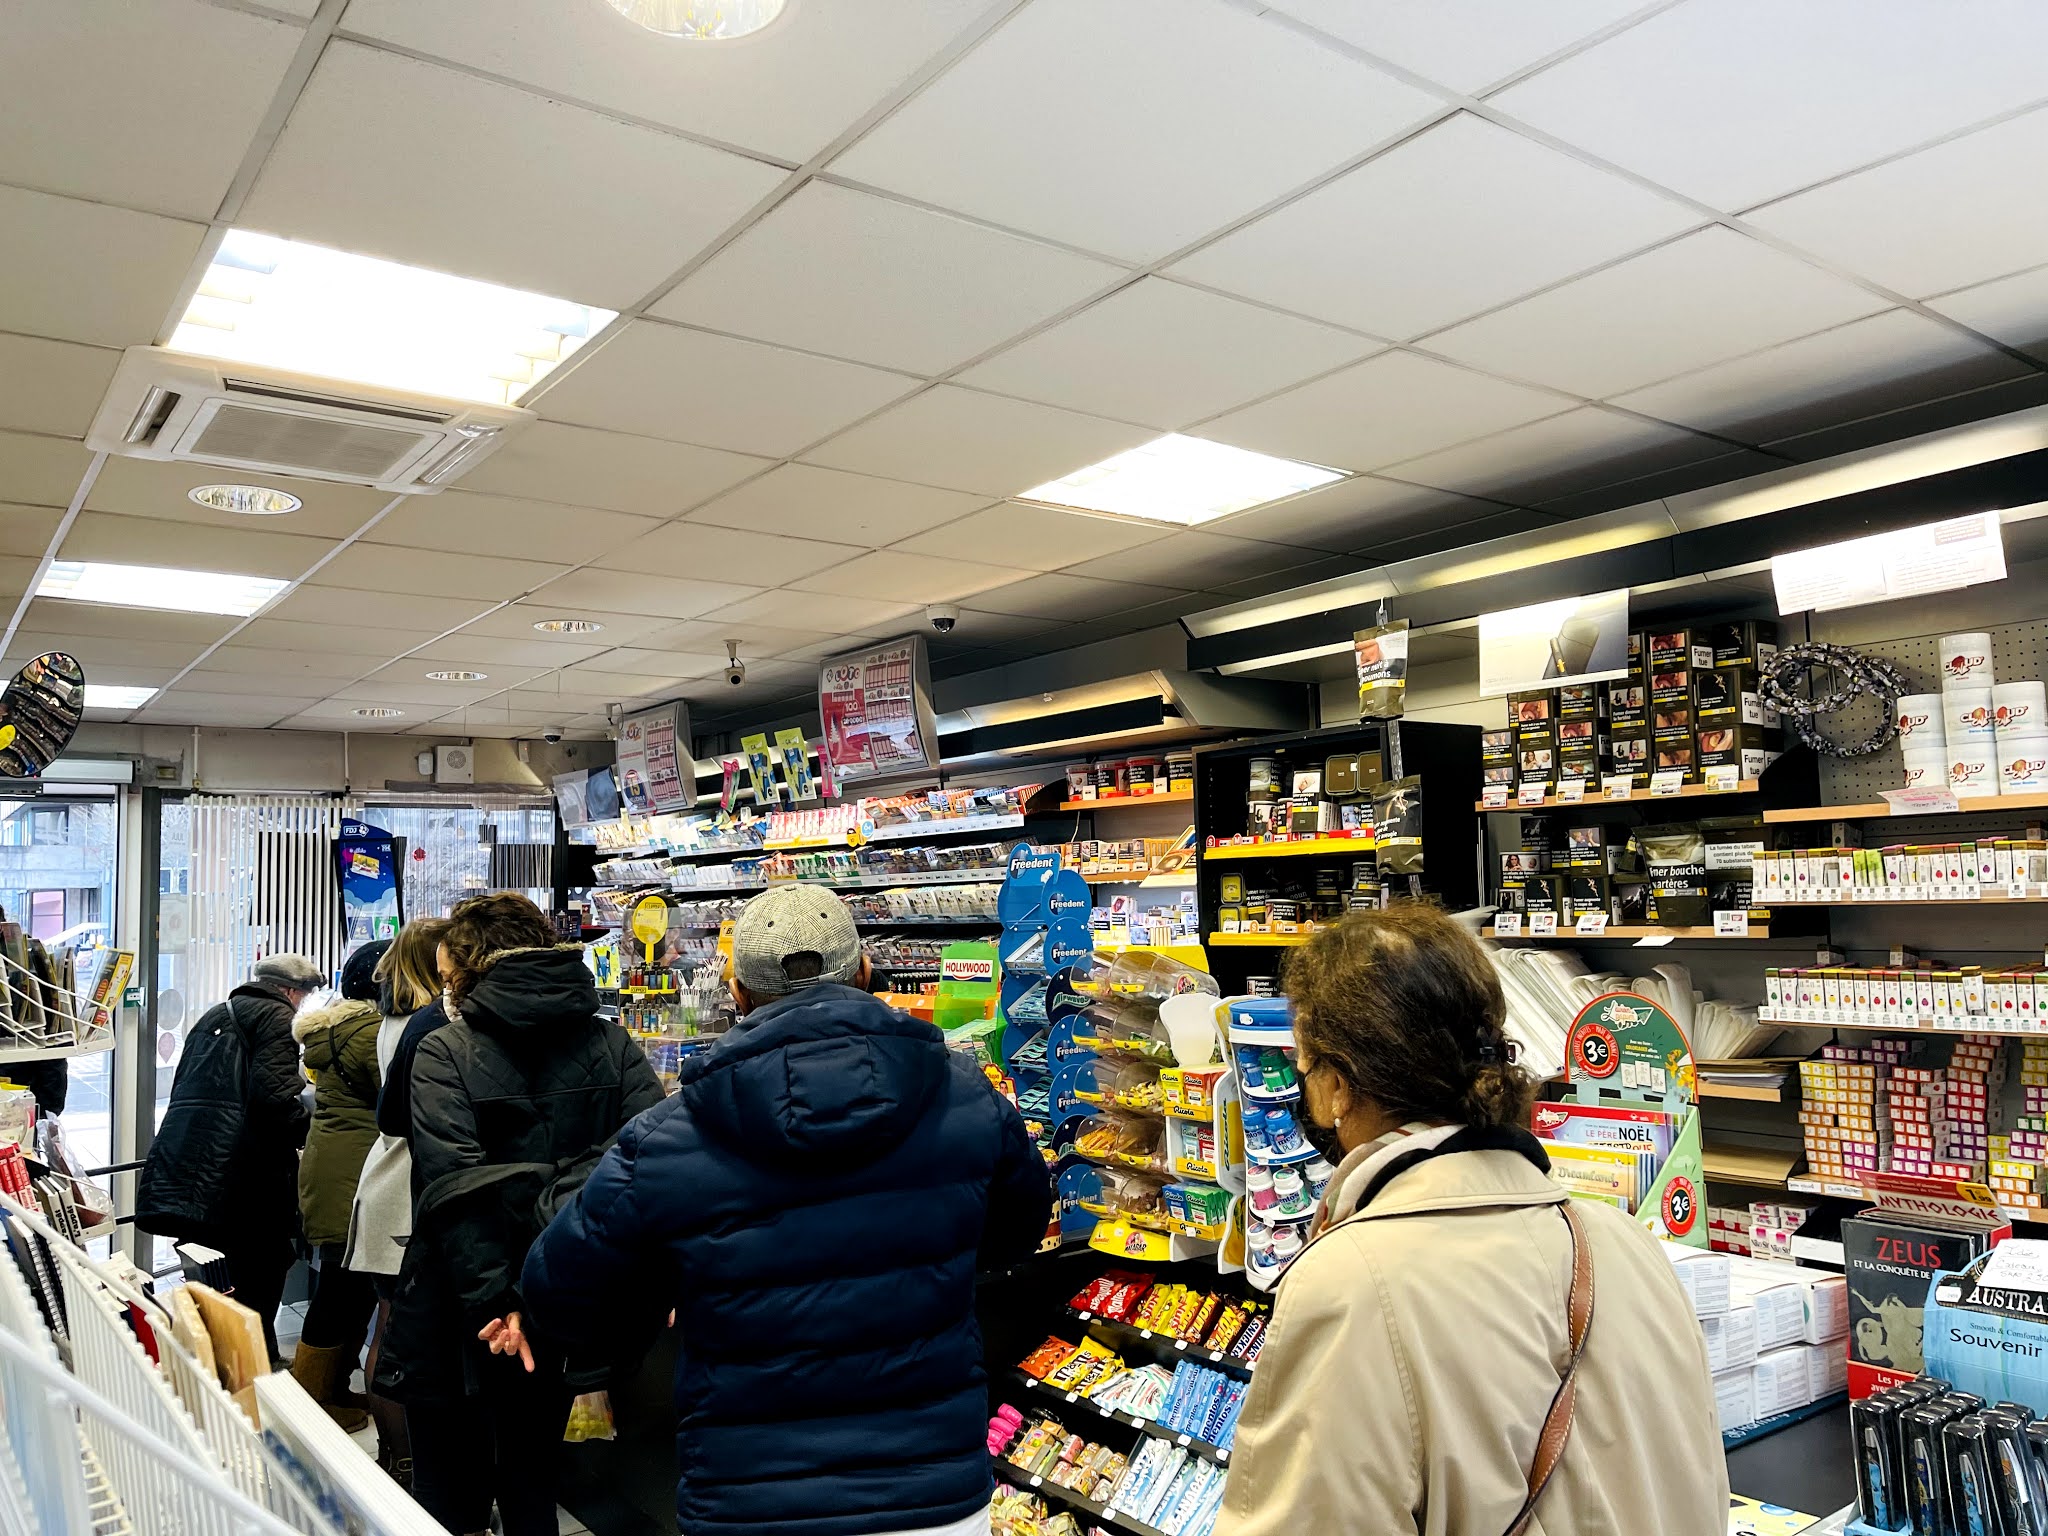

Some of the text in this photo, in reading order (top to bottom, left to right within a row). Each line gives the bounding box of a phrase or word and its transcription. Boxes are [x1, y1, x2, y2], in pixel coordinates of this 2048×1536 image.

[1694, 648, 1712, 657] Fumer
[1699, 658, 1707, 666] tue
[834, 664, 860, 682] LOTO
[1744, 698, 1762, 708] Fumer
[1750, 710, 1758, 718] tue
[1744, 755, 1763, 764] Fumer
[1750, 766, 1760, 775] tue
[1208, 838, 1213, 846] S
[1011, 858, 1053, 870] Freedent
[1670, 865, 1705, 876] bouche
[1657, 879, 1688, 888] artères
[1050, 900, 1085, 909] Freedent
[1053, 948, 1087, 958] Freedent
[945, 962, 991, 974] HOLLYWOOD
[1585, 1040, 1607, 1062] 3€
[1174, 1106, 1194, 1115] Ricola
[1598, 1129, 1617, 1139] PÈRE
[1619, 1126, 1653, 1141] NOËL
[1187, 1162, 1208, 1173] Ricola
[1672, 1196, 1689, 1220] 3€
[1879, 1195, 2000, 1222] MYTHOLOGIE
[67, 1205, 81, 1237] L'appât
[1876, 1237, 1941, 1268] ZEUS
[1865, 1262, 1875, 1270] LA
[1876, 1265, 1919, 1278] CONQUÊTE
[1921, 1271, 1931, 1279] DE
[1194, 1296, 1215, 1330] LION
[1970, 1323, 1996, 1332] Smooth
[1950, 1329, 2042, 1357] Souvenir
[1186, 1369, 1199, 1397] mentos
[1878, 1373, 1891, 1384] Les
[1169, 1398, 1181, 1425] mentos
[1185, 1403, 1198, 1434] mentos
[1202, 1397, 1219, 1439] mentos
